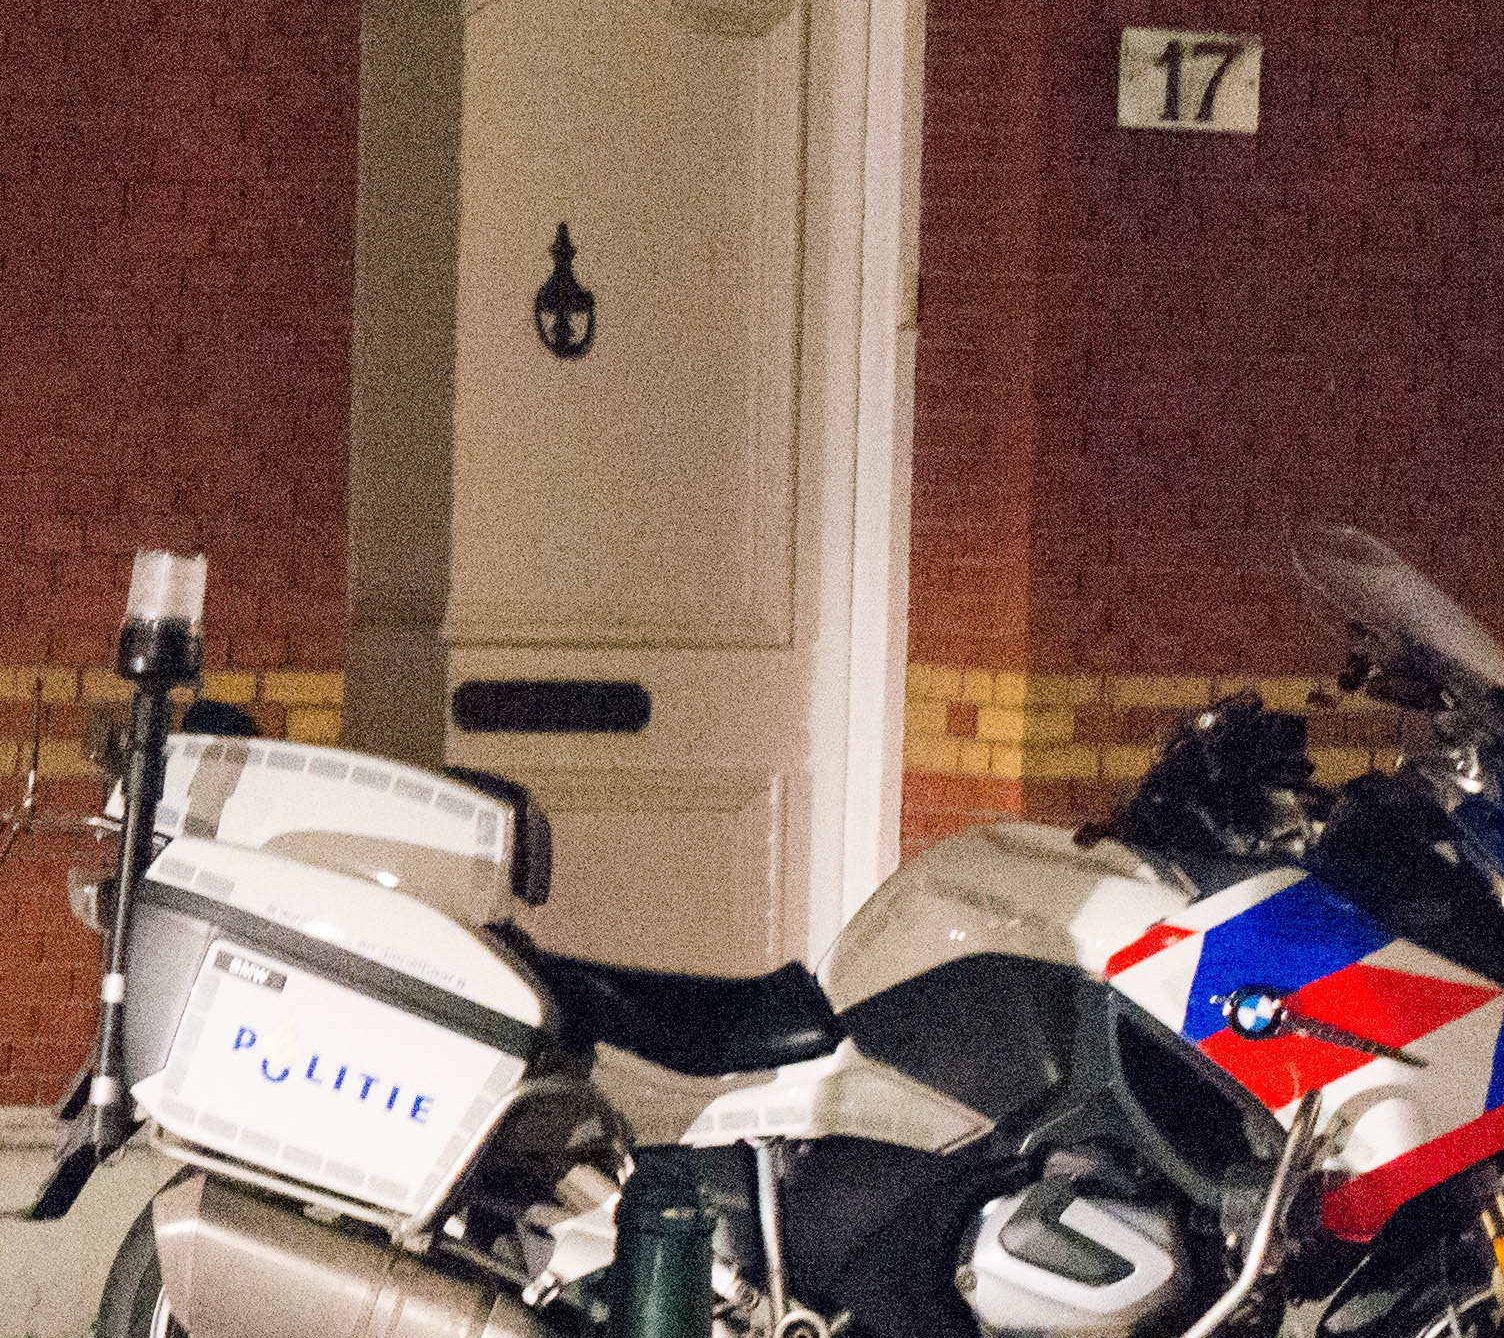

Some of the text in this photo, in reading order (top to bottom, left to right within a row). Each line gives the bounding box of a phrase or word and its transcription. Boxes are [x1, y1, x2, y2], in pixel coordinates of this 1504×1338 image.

[1153, 39, 1246, 123] 17
[229, 956, 270, 986] BMW
[232, 1025, 435, 1124] POLITIE
